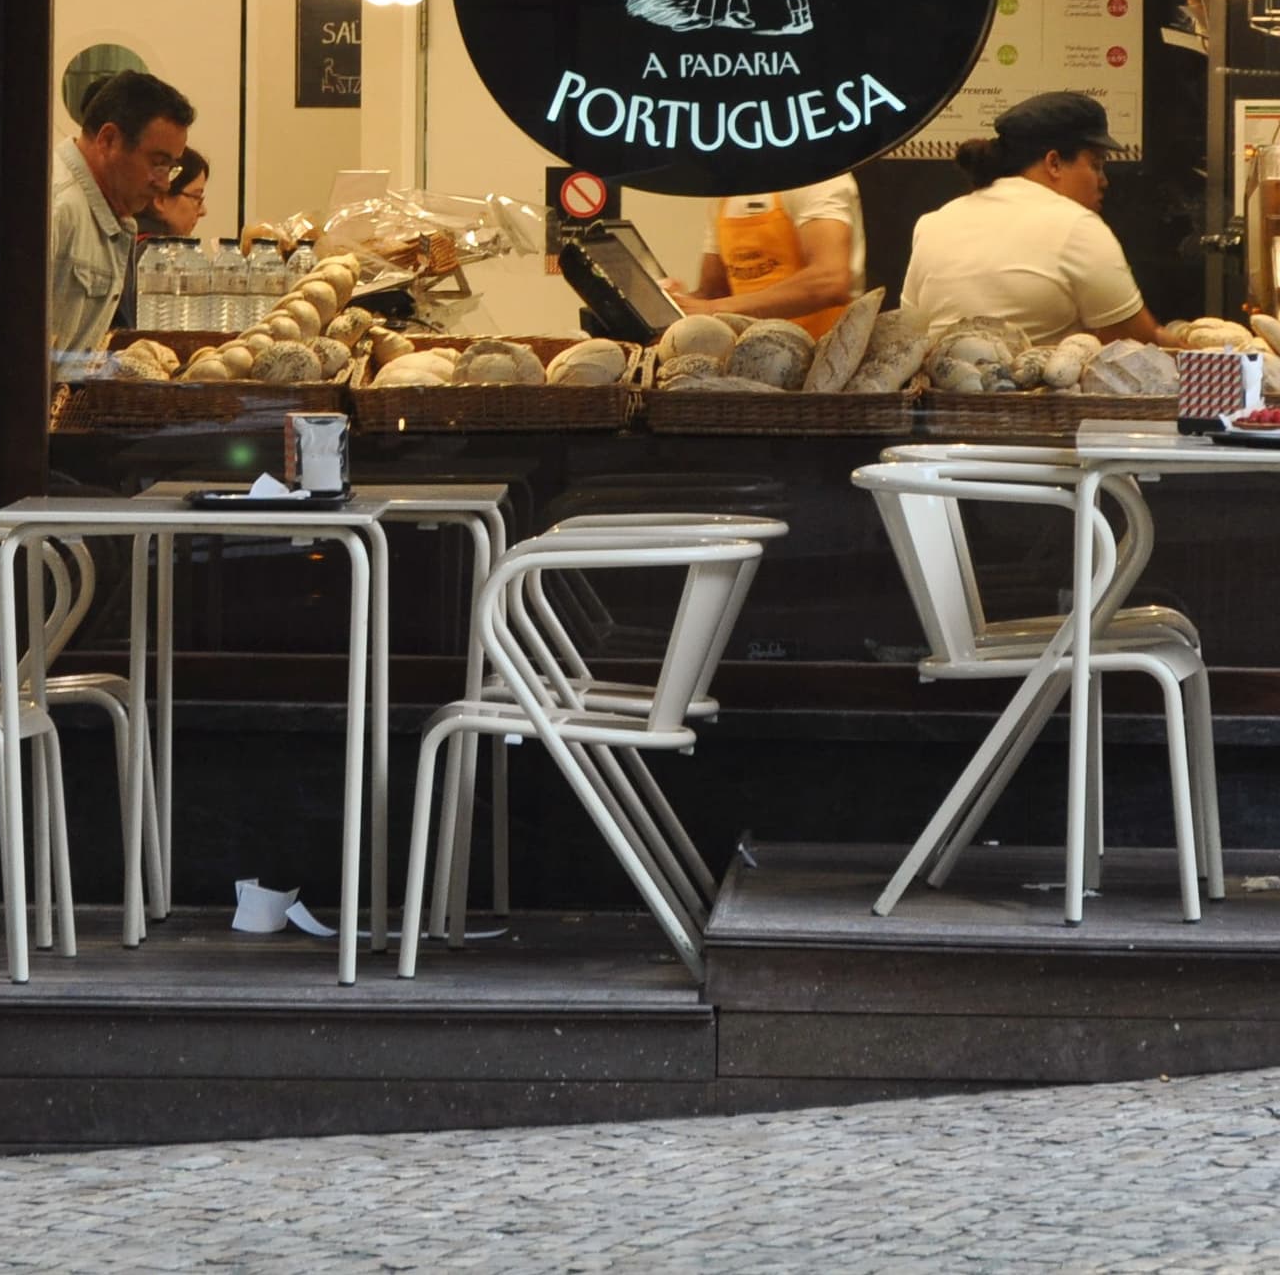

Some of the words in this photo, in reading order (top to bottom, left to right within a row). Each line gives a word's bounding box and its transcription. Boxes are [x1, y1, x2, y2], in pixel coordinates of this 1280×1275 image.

[642, 52, 668, 79] A
[680, 51, 801, 78] PADARIA
[546, 70, 907, 152] PORTUGUESA
